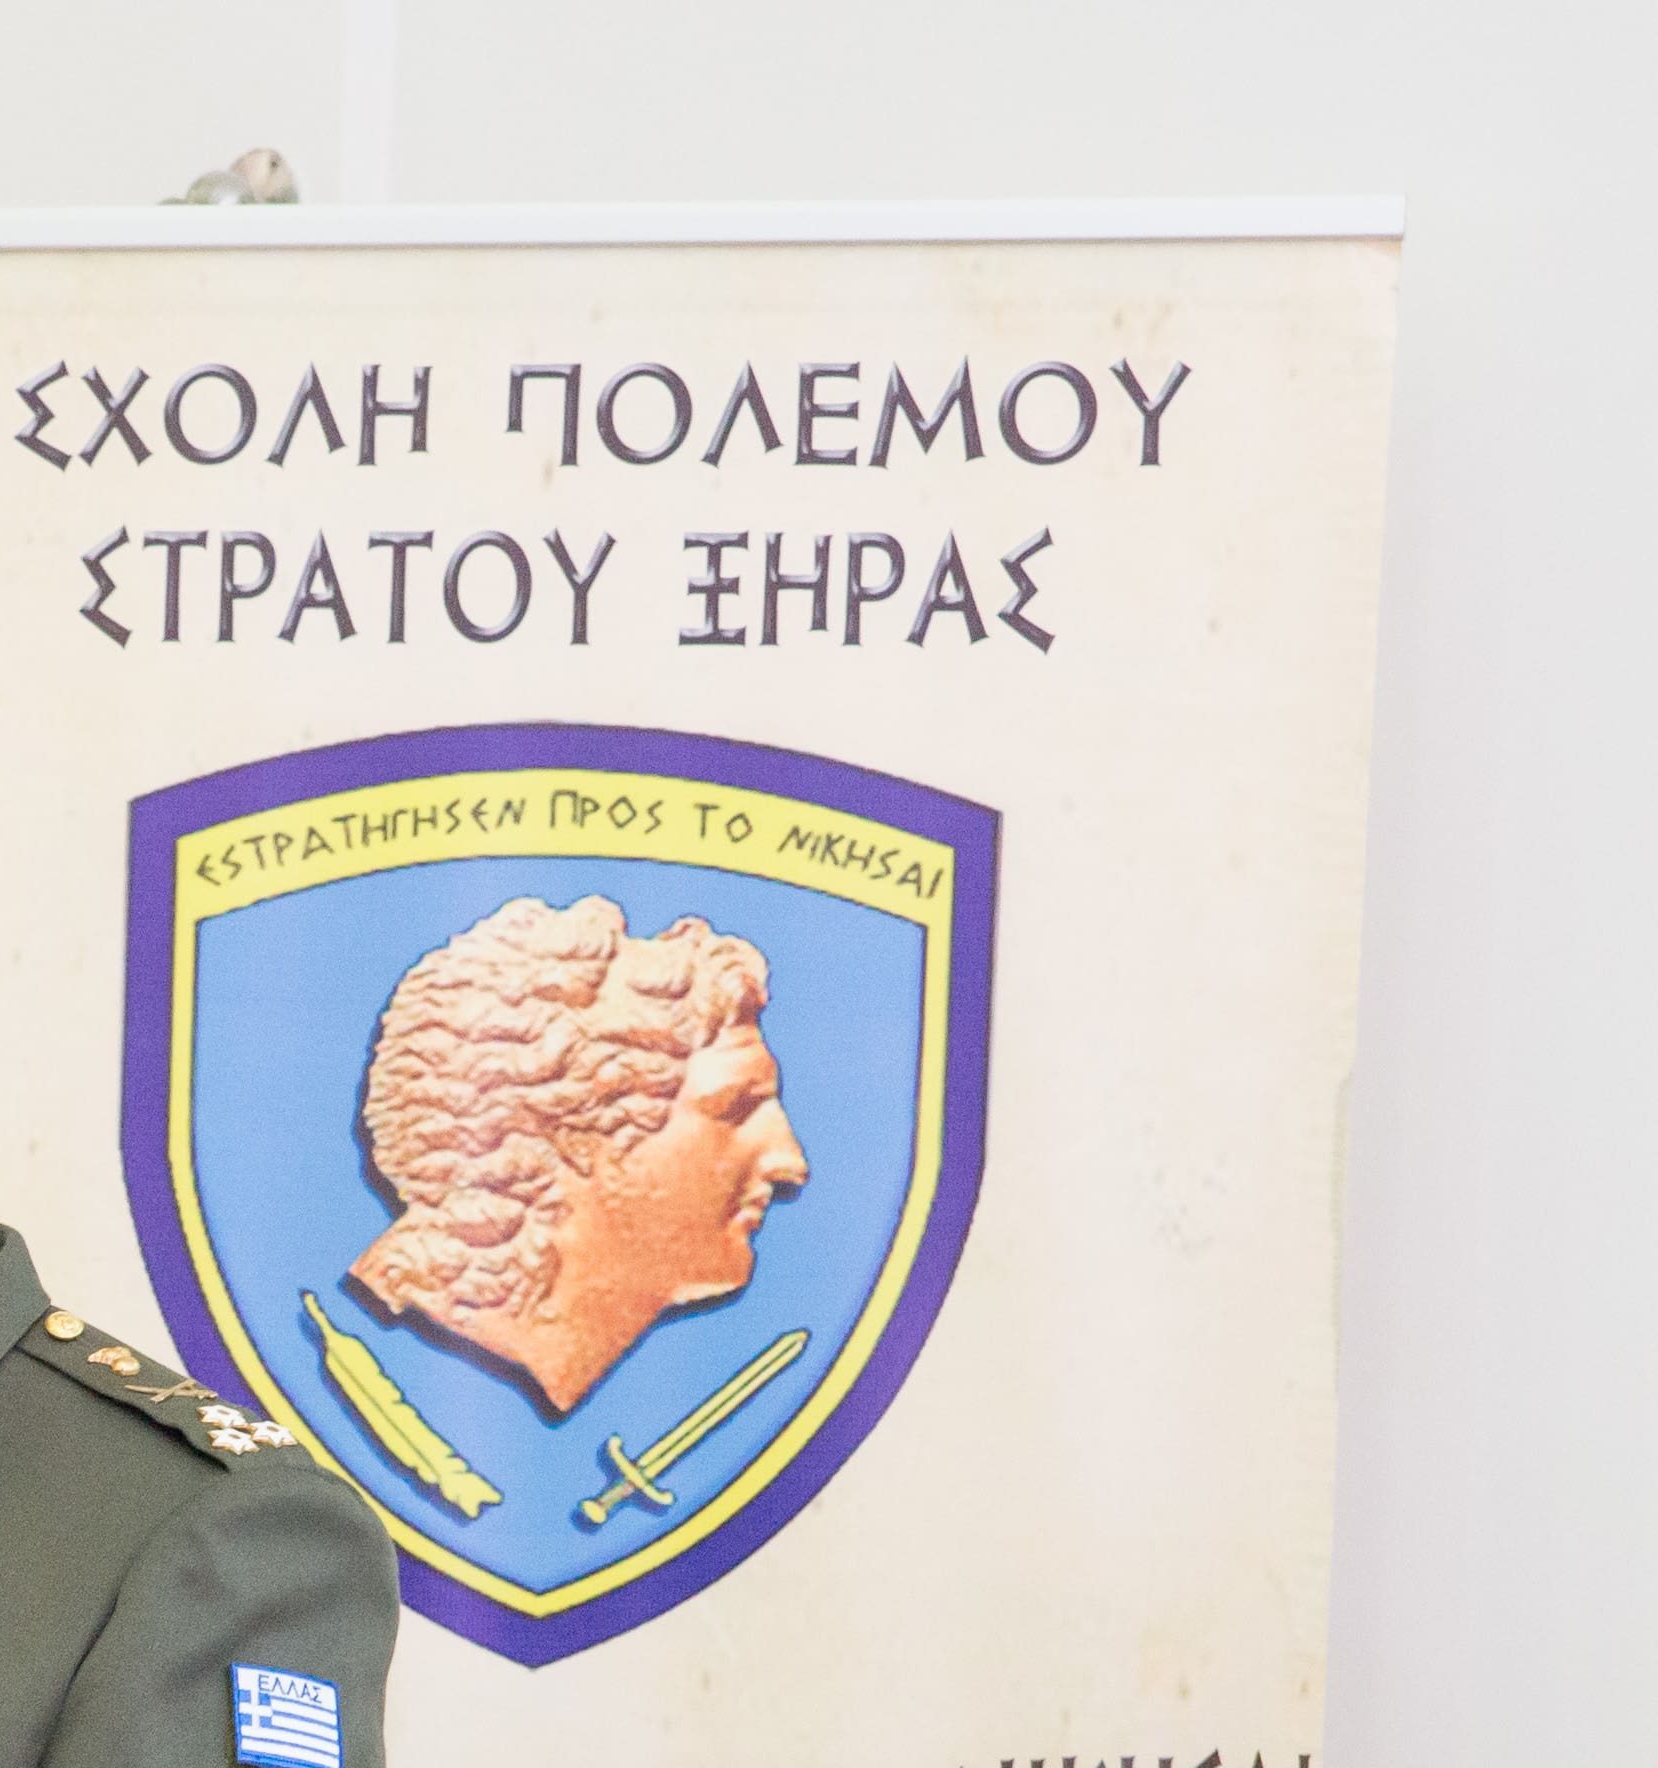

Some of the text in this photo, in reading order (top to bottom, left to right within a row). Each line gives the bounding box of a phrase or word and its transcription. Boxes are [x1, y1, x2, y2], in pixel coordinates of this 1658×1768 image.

[14, 354, 1193, 472] ΣΧΟΛΗ ΠΟΛΕΜΟΥ
[79, 525, 1056, 655] ΣΤΡΑΤΟΥ ΞΗΡΑΣ
[693, 802, 753, 843] ΤΟ
[258, 1674, 322, 1704] ΕΛΛΑΣ
